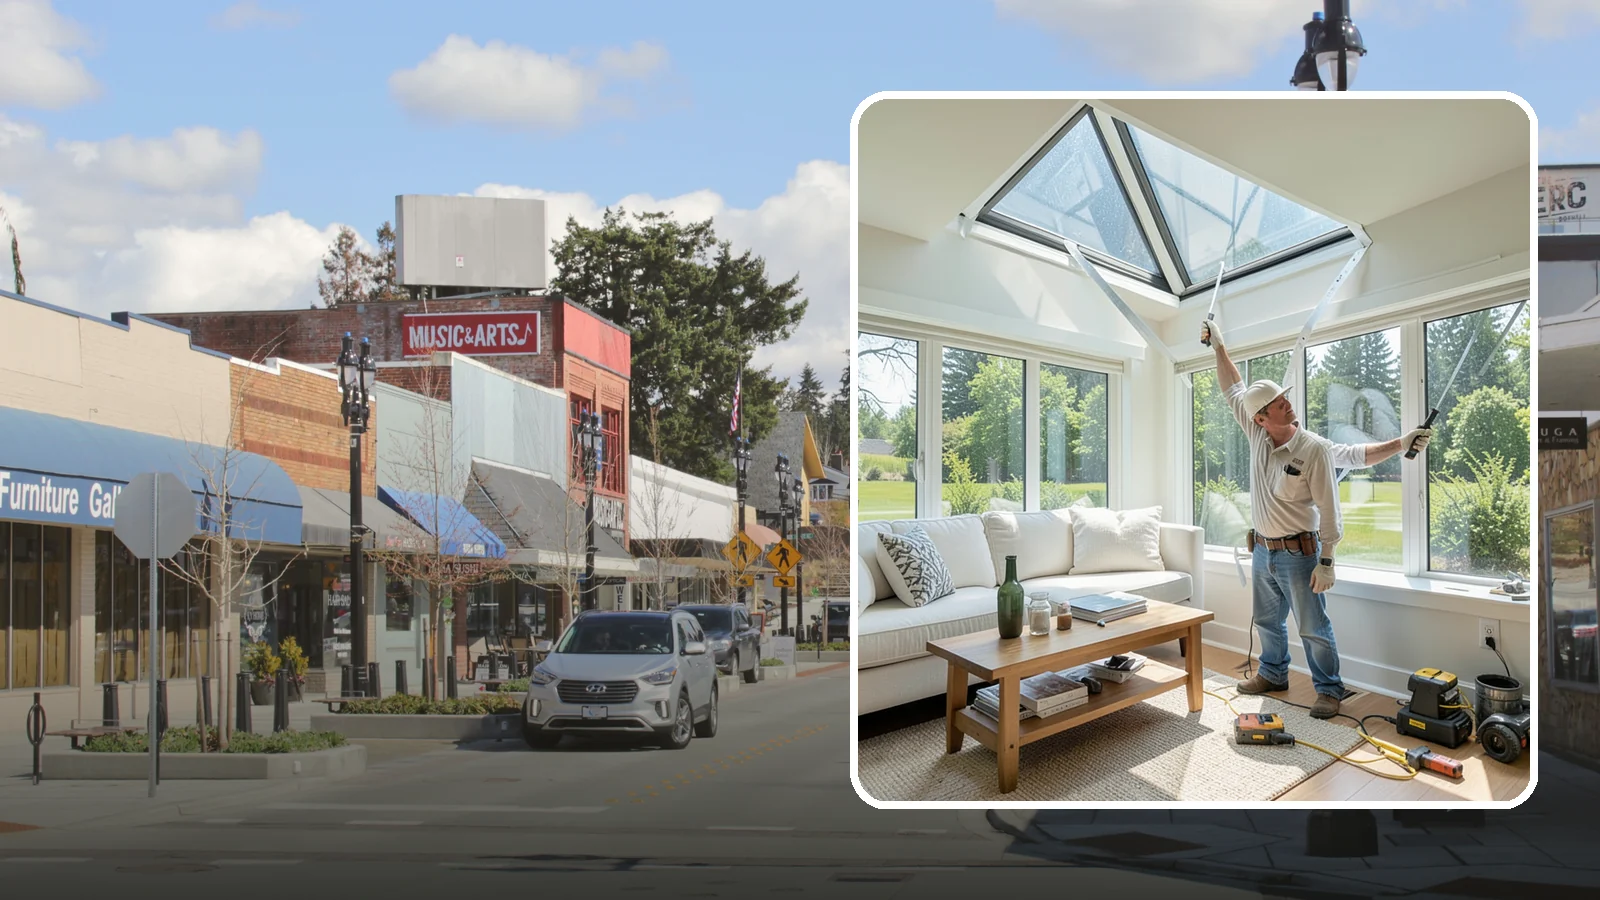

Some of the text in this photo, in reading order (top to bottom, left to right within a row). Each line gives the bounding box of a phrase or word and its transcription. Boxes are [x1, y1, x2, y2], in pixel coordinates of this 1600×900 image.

[409, 323, 519, 348] MUSIC&ARTS
[0, 471, 122, 519] Furniture Gal
